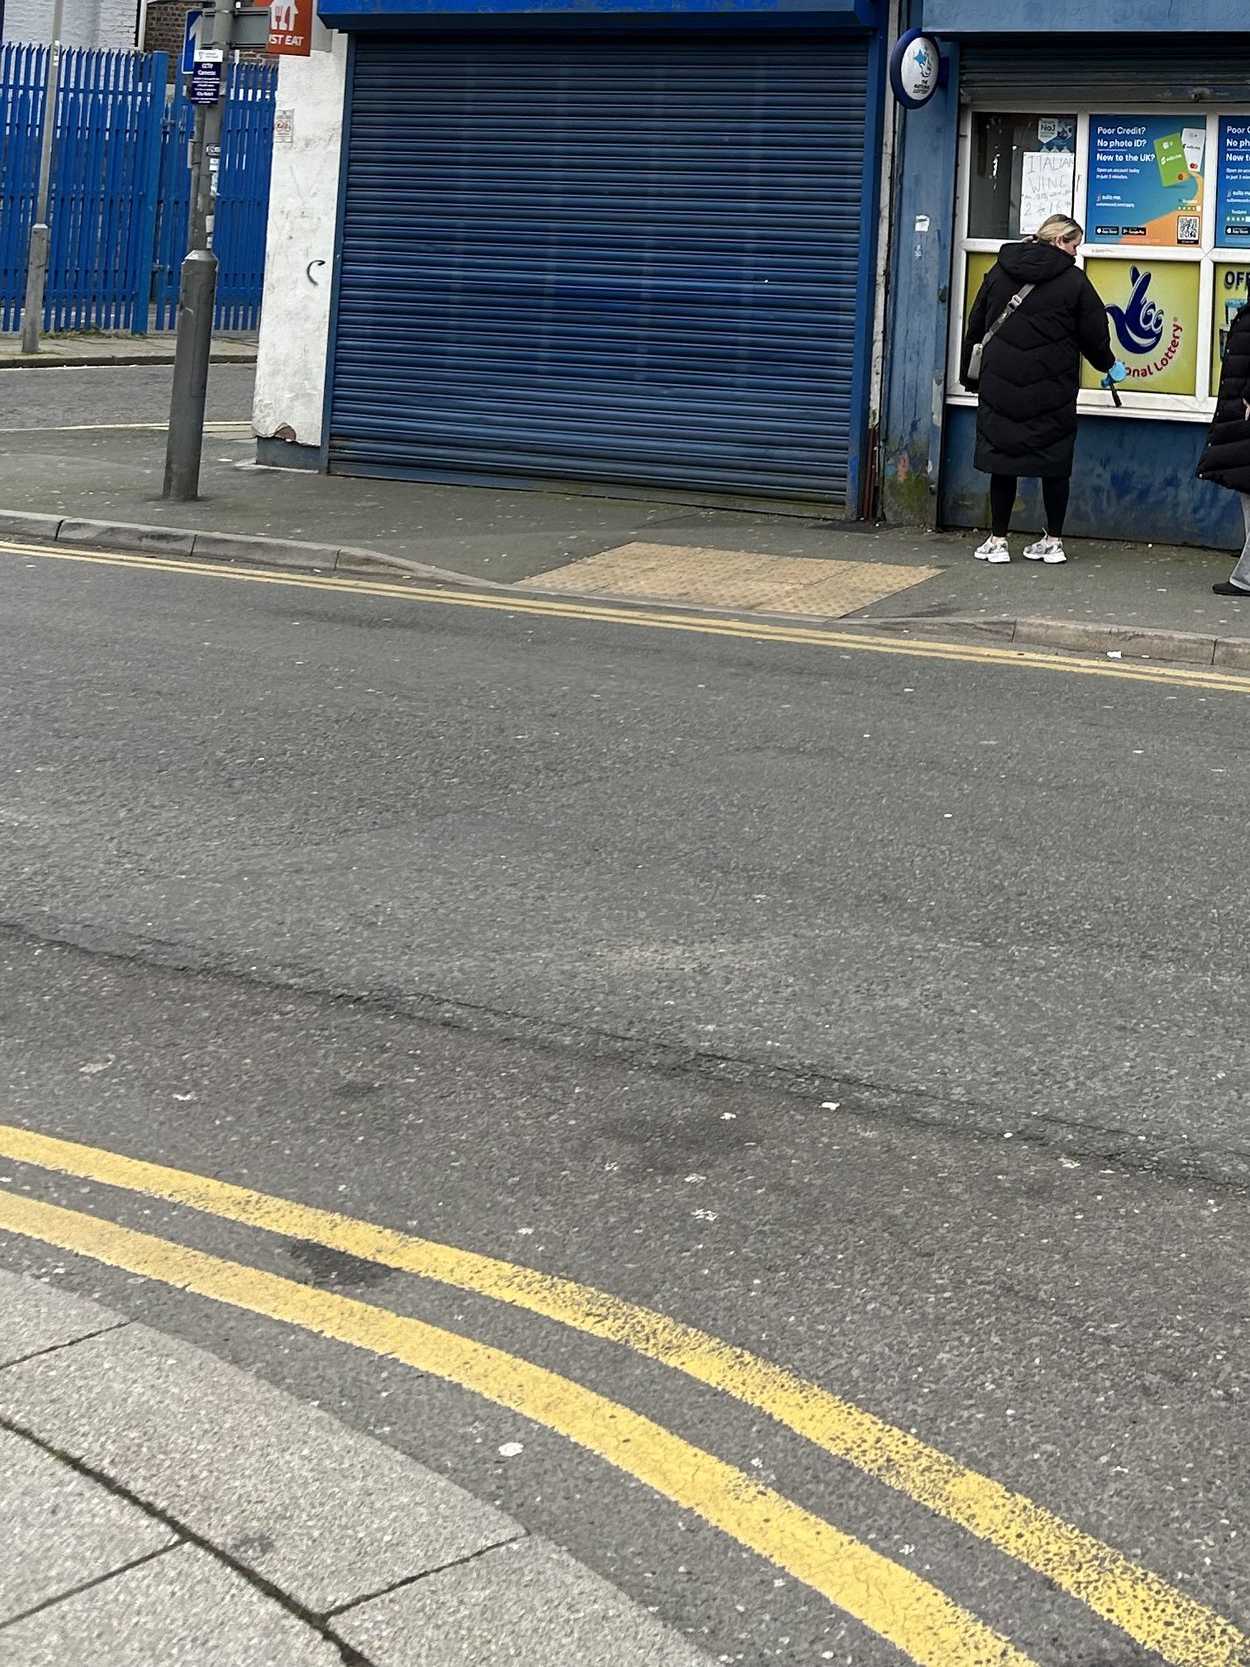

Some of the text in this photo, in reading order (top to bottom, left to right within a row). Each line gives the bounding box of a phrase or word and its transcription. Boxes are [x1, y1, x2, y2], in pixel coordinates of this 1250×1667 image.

[285, 36, 304, 46] EAT
[1097, 126, 1146, 135] Poor Credit?
[1227, 126, 1245, 134] Poor
[1097, 139, 1147, 148] No photo ID?
[1226, 138, 1237, 147] No
[1096, 153, 1155, 162] New to the UK?
[1226, 153, 1244, 162] New
[1026, 155, 1074, 174] ITALIAN
[1028, 175, 1066, 193] WINE
[1153, 323, 1184, 371] Lottery
